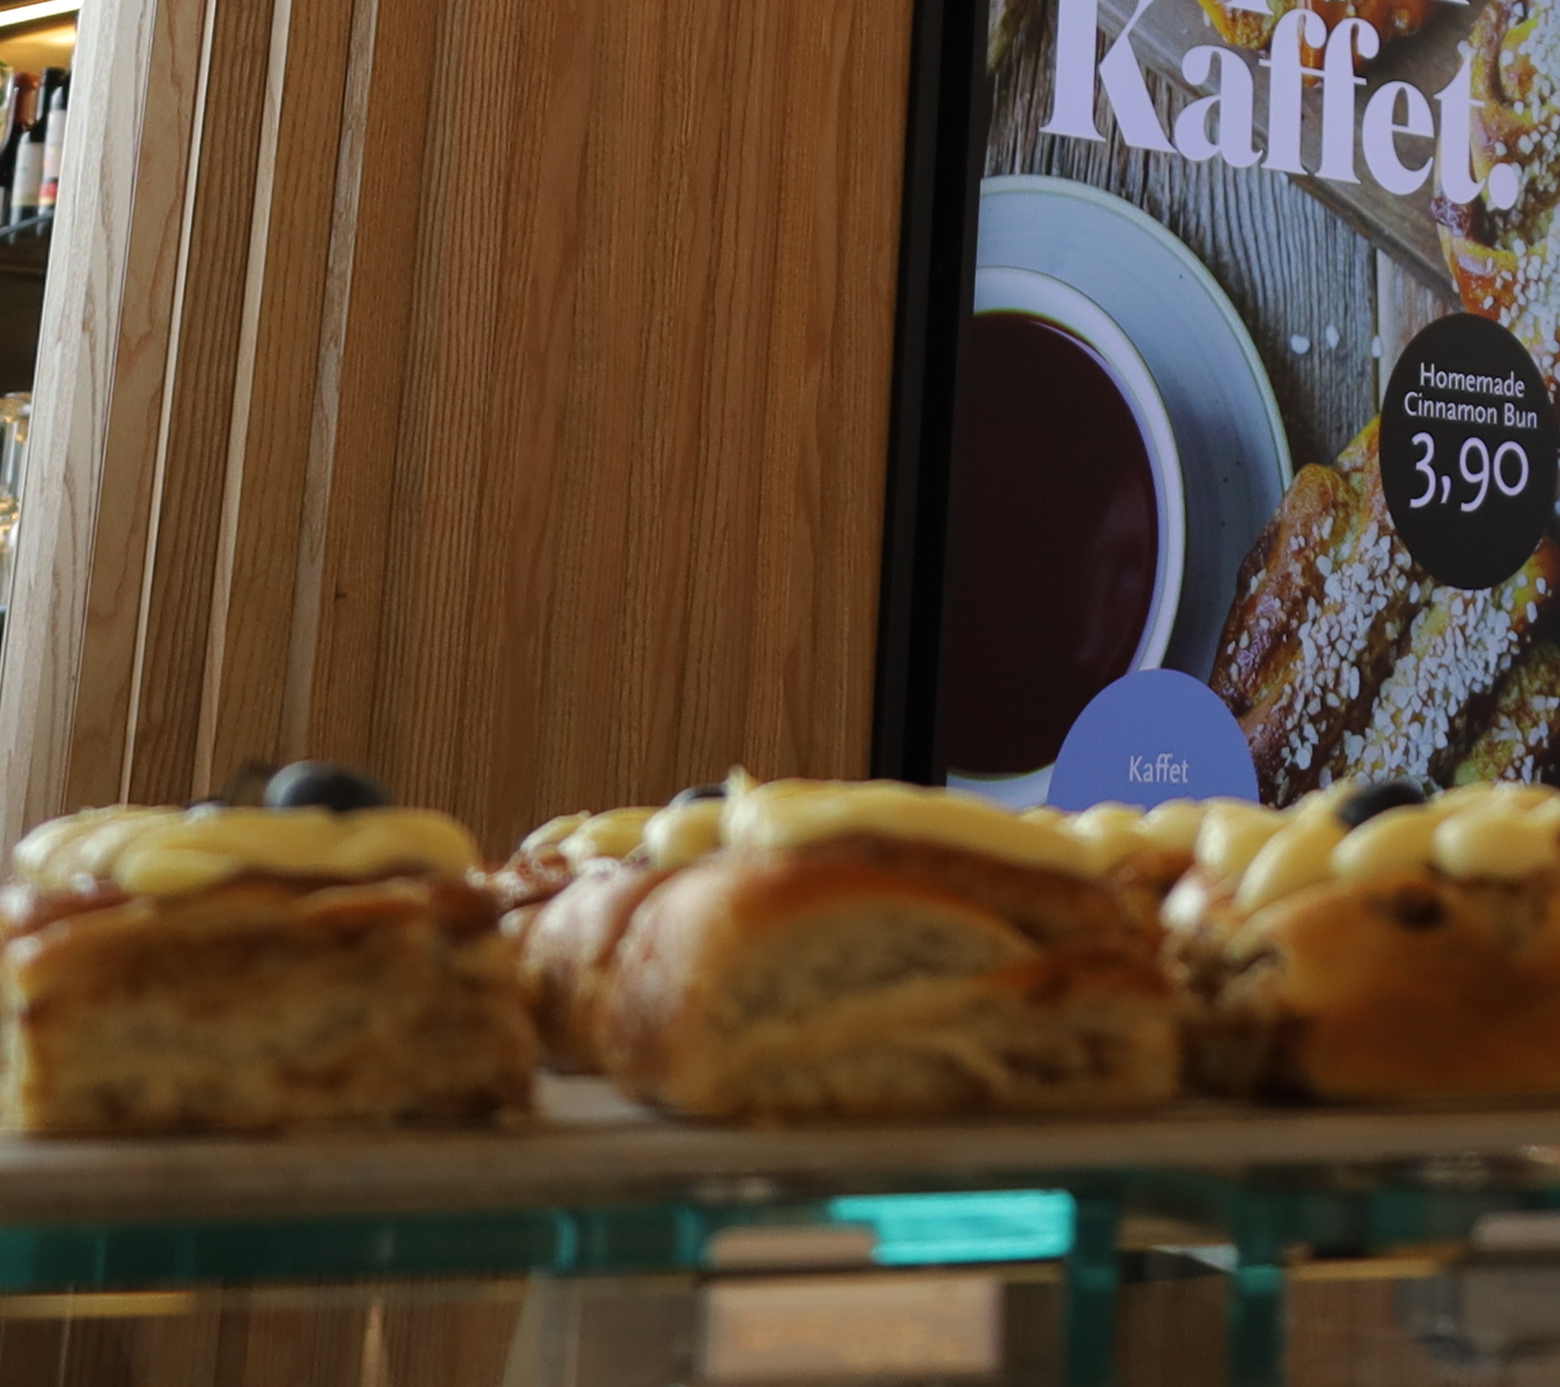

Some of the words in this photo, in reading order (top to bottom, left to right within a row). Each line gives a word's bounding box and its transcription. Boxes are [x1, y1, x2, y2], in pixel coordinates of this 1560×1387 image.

[1419, 362, 1525, 398] Homemade
[1404, 391, 1498, 425] Cinnamon
[1503, 402, 1538, 429] Bun
[1409, 431, 1529, 512] 3,90
[1128, 753, 1190, 784] Kaffet
